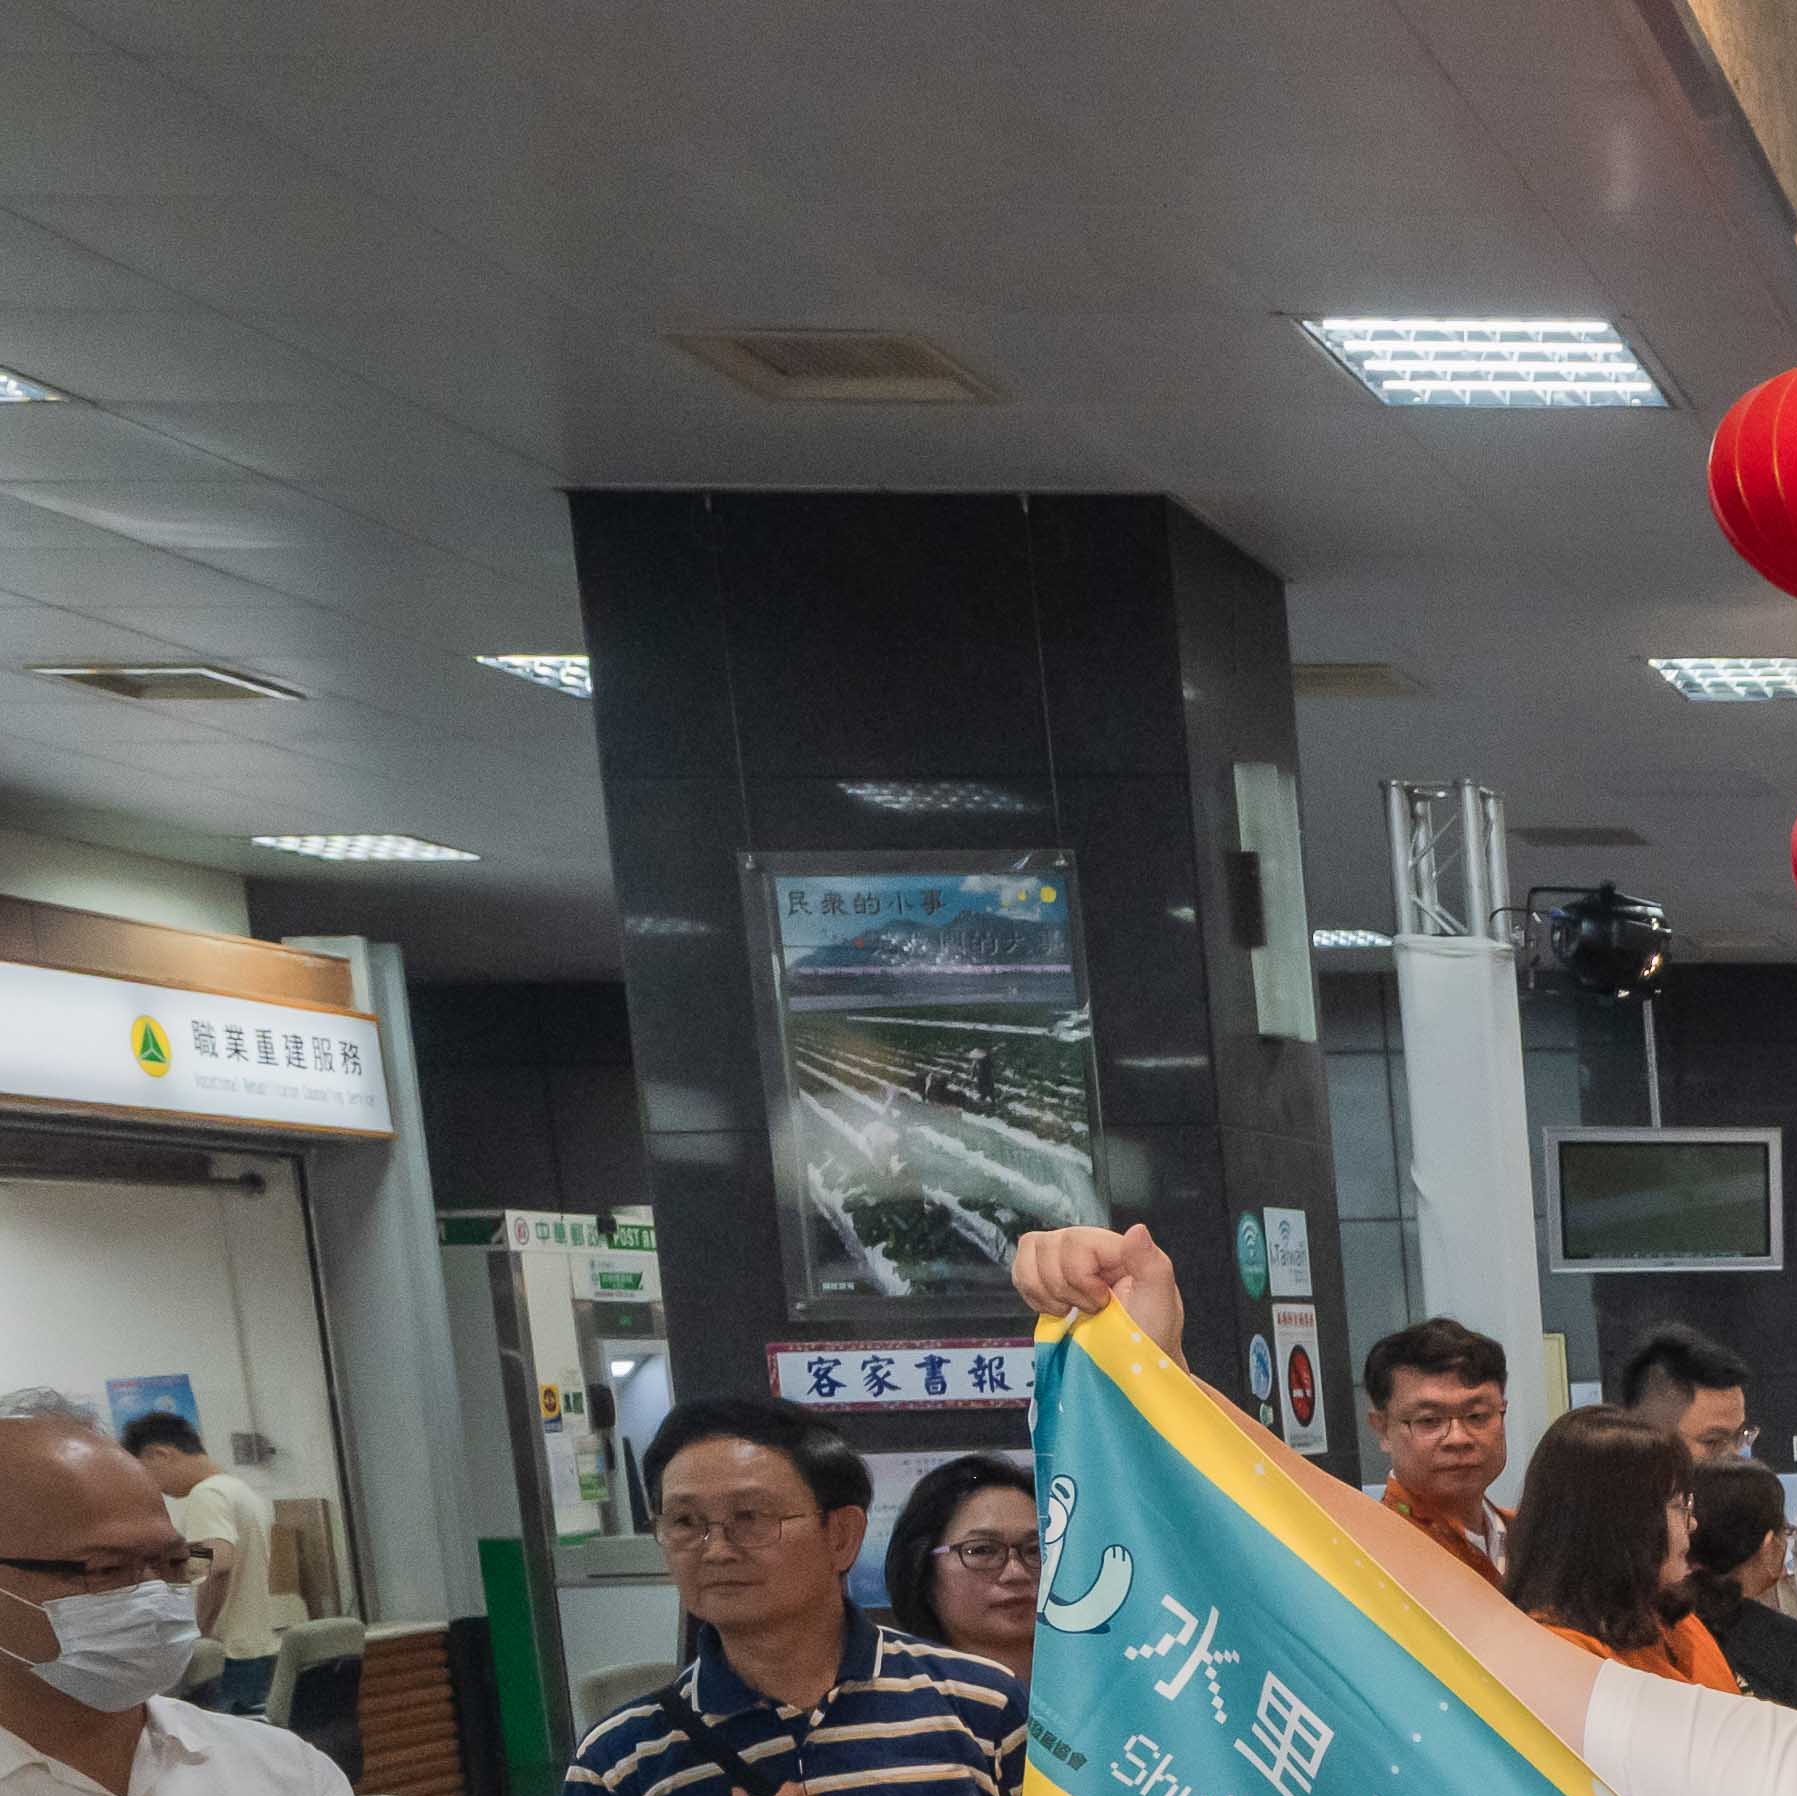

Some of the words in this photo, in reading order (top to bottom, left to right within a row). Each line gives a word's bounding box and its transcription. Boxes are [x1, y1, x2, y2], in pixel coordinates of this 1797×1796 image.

[190, 1018, 364, 1078] 職業重建服務
[806, 1354, 1036, 1398] 客家書報
